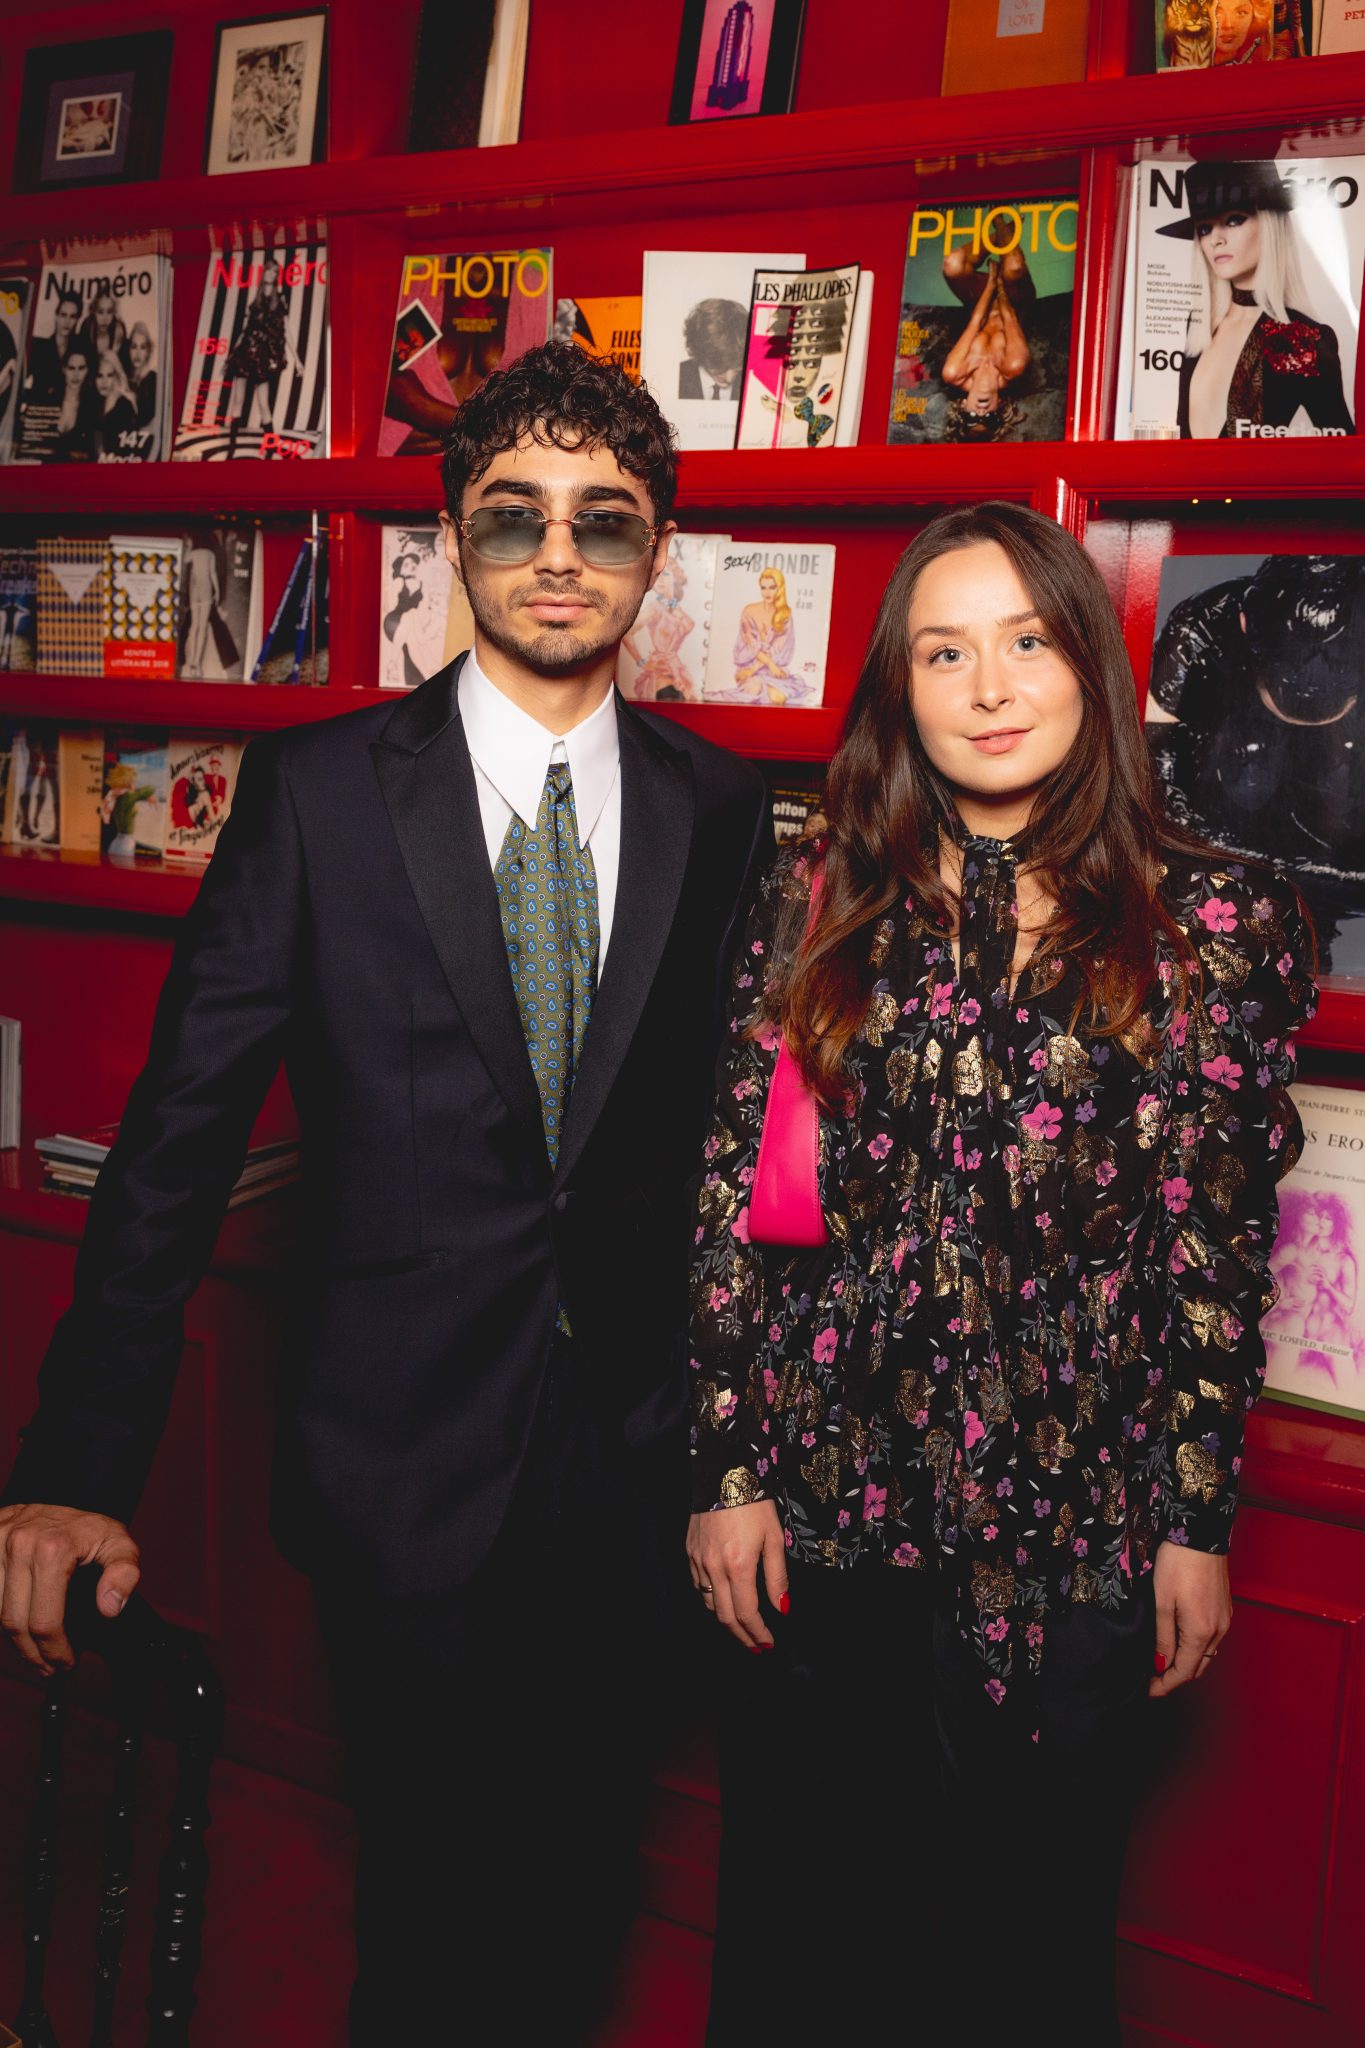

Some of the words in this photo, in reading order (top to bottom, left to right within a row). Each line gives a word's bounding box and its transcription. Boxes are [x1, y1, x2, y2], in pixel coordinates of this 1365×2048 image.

[1007, 12, 1035, 28] LOVE
[45, 265, 152, 300] Numéro
[403, 255, 548, 298] PHOTO
[756, 283, 780, 302] LES
[611, 330, 642, 348] ELLES
[1139, 348, 1185, 372] 160
[118, 430, 150, 448] 147
[258, 433, 312, 460] Pop
